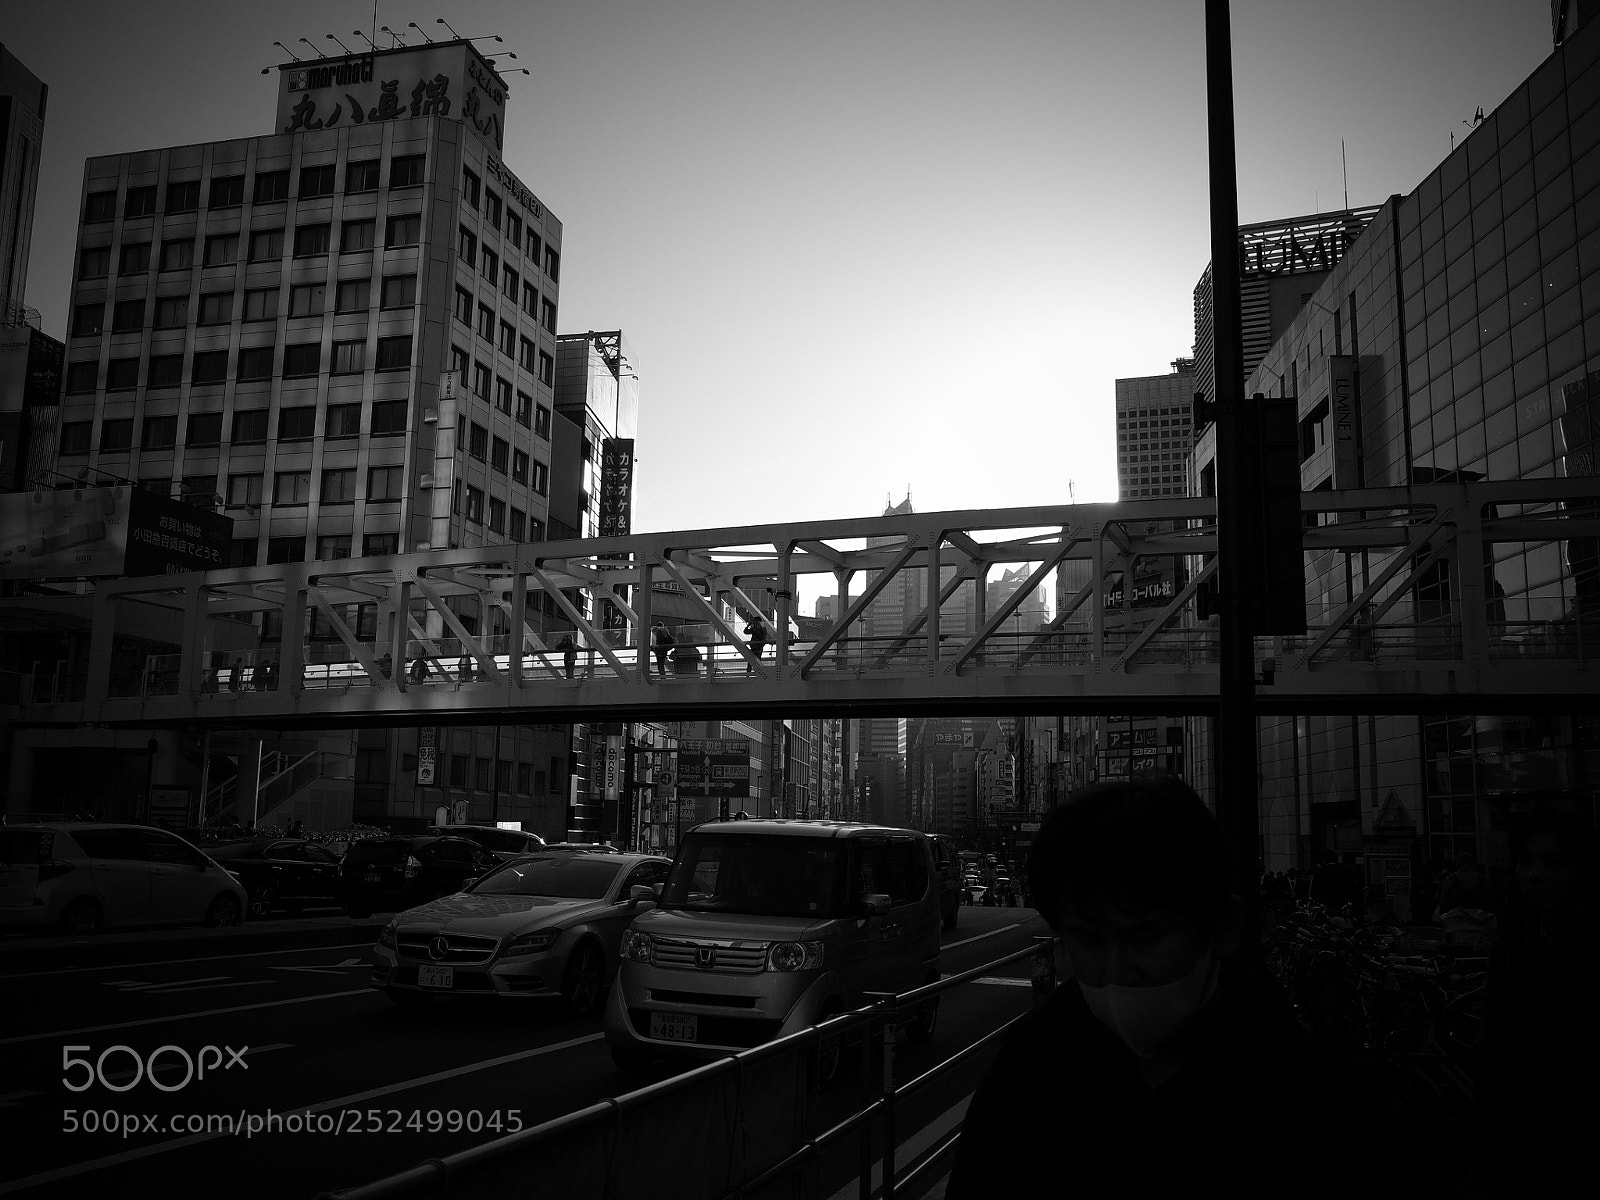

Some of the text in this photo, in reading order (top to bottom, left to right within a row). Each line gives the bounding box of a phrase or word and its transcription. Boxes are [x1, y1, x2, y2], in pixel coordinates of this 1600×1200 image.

[1335, 379, 1352, 431] LUMINE
[617, 452, 630, 535] カラオケ&
[159, 514, 203, 539] お買い物は
[607, 748, 617, 788] docomo
[660, 1023, 695, 1040] 48-13
